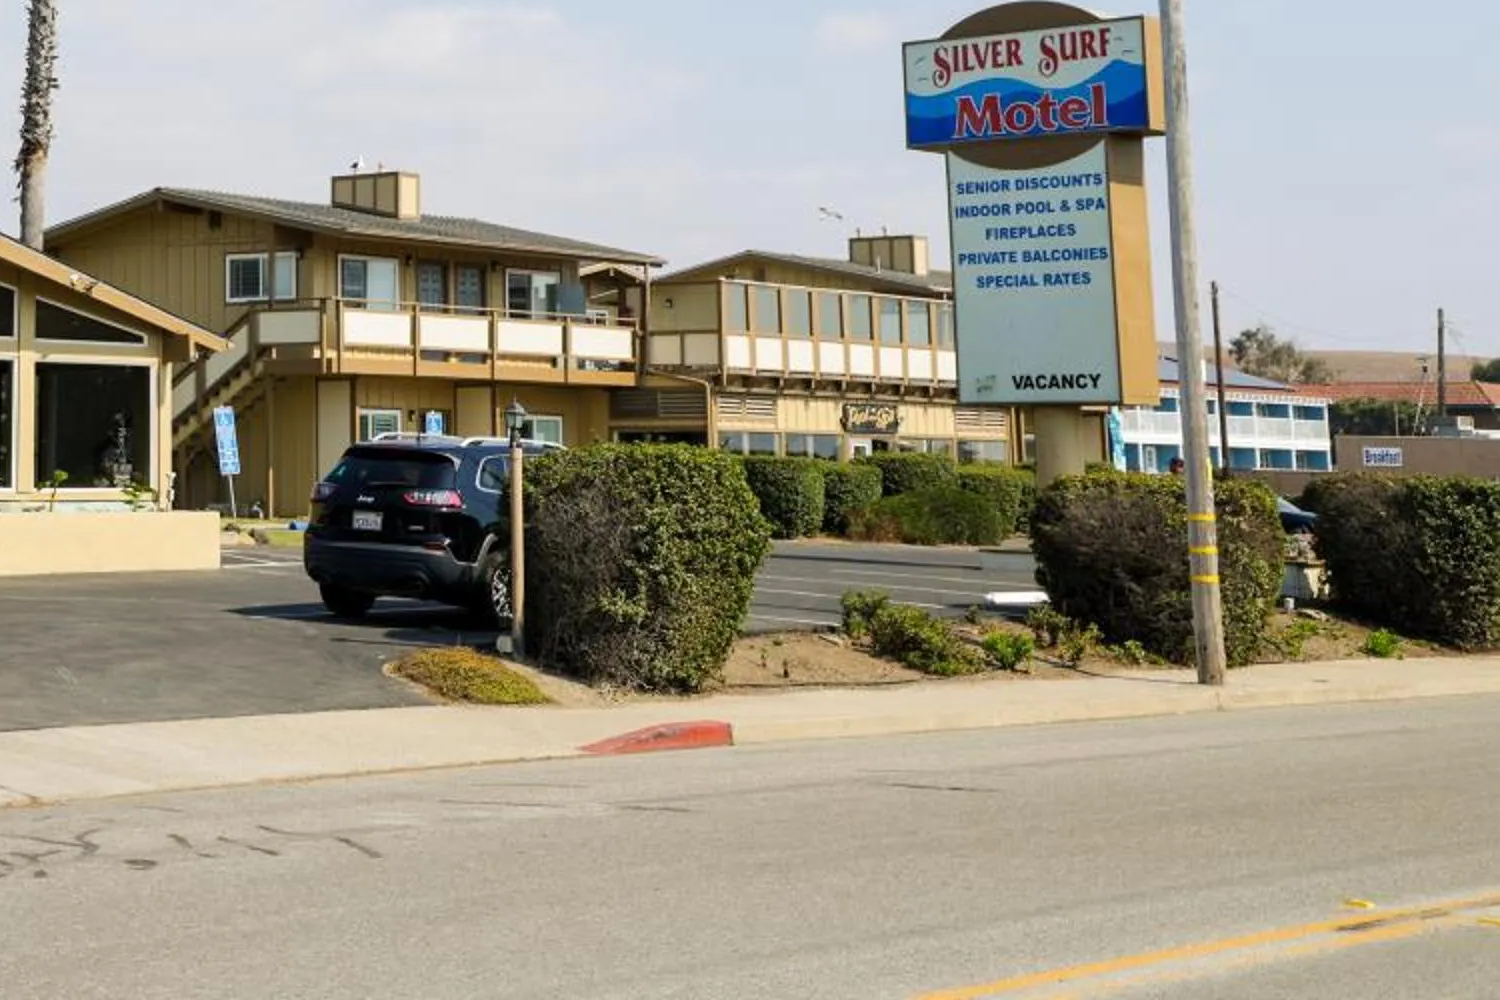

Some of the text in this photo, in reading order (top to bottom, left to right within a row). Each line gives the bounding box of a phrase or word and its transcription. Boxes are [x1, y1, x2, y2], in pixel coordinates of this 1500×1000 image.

[932, 27, 1111, 88] SILVER SURF
[951, 81, 1109, 139] Motel
[955, 173, 1103, 195] SENIOR DISCOUNTS
[955, 198, 1105, 219] INDOOR POOL & SPA
[985, 223, 1077, 240] FIREPLACES
[958, 247, 1108, 265] PRIVATE BALCONIES
[976, 271, 1092, 289] SPECIAL RATES
[1011, 373, 1101, 390] VACANCY
